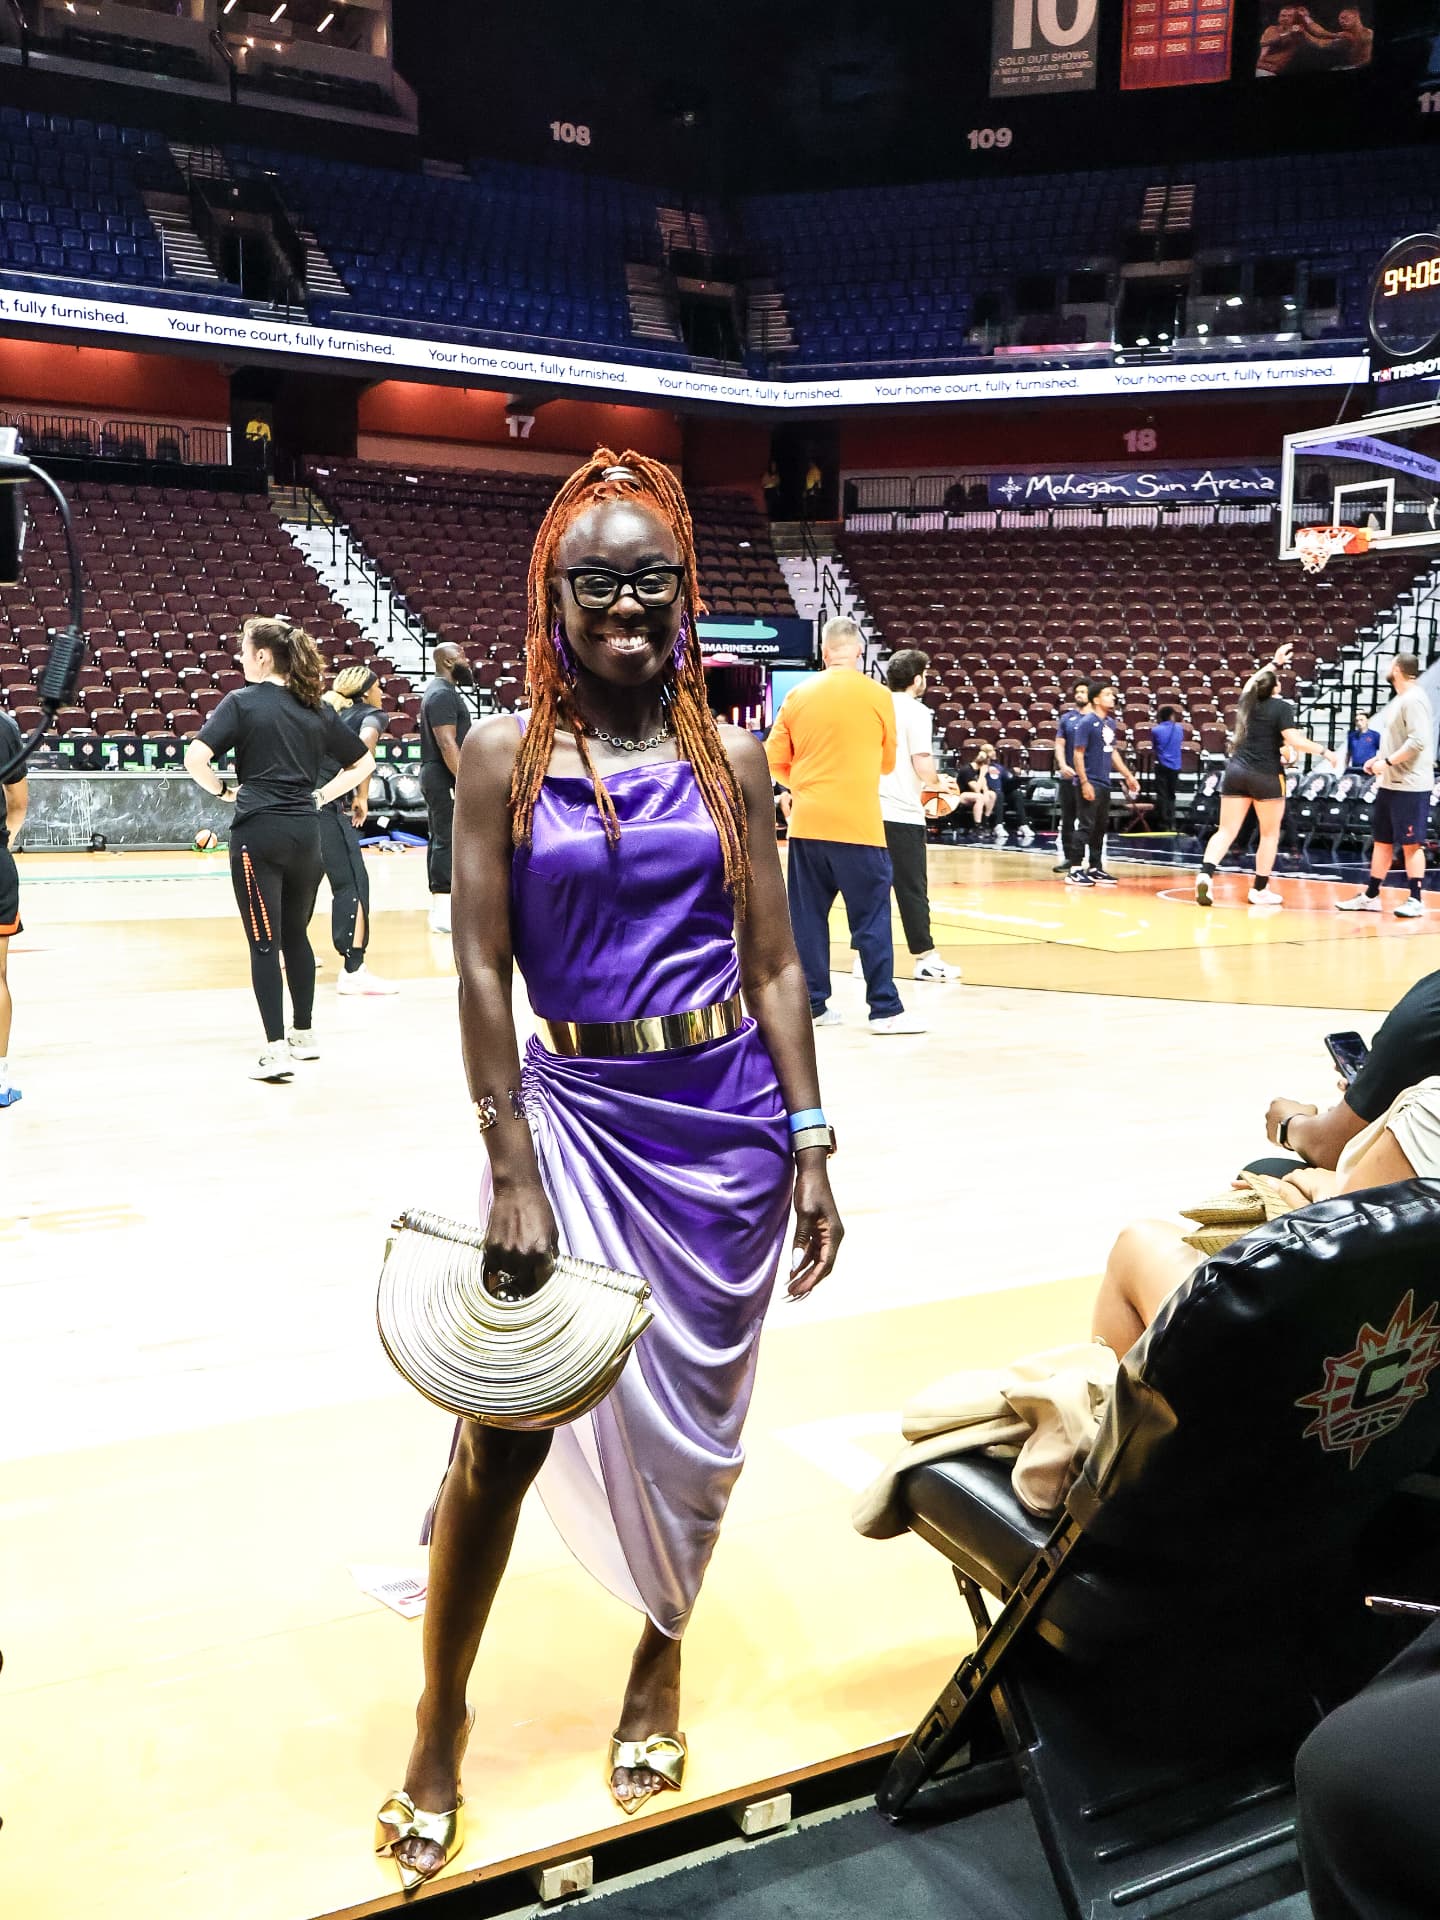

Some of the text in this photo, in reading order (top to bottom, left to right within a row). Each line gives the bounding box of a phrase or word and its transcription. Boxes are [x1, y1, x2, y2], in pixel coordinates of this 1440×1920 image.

[1012, 0, 1097, 50] 10
[999, 50, 1089, 67] SOLD OUT SHOWS
[1001, 67, 1020, 75] NEW
[1021, 63, 1060, 74] ENGLAND
[1061, 60, 1093, 71] RECORD
[550, 121, 591, 147] 108
[967, 127, 1013, 150] 109
[13, 299, 47, 318] fully
[51, 303, 129, 325] furnished.
[167, 317, 396, 356] Your home court, fully furnished.
[428, 348, 628, 383] Your home court, fully furnished.
[1114, 365, 1336, 386] Your home court, fully furnished.
[657, 376, 843, 401] Your home court, fully furnished.
[874, 377, 1080, 396] Your home court, fully furnished.
[505, 415, 536, 438] 17
[1123, 428, 1157, 452] 18
[1025, 470, 1276, 501] Mohegan Sun Arena
[700, 643, 780, 654] BMARINES.COM
